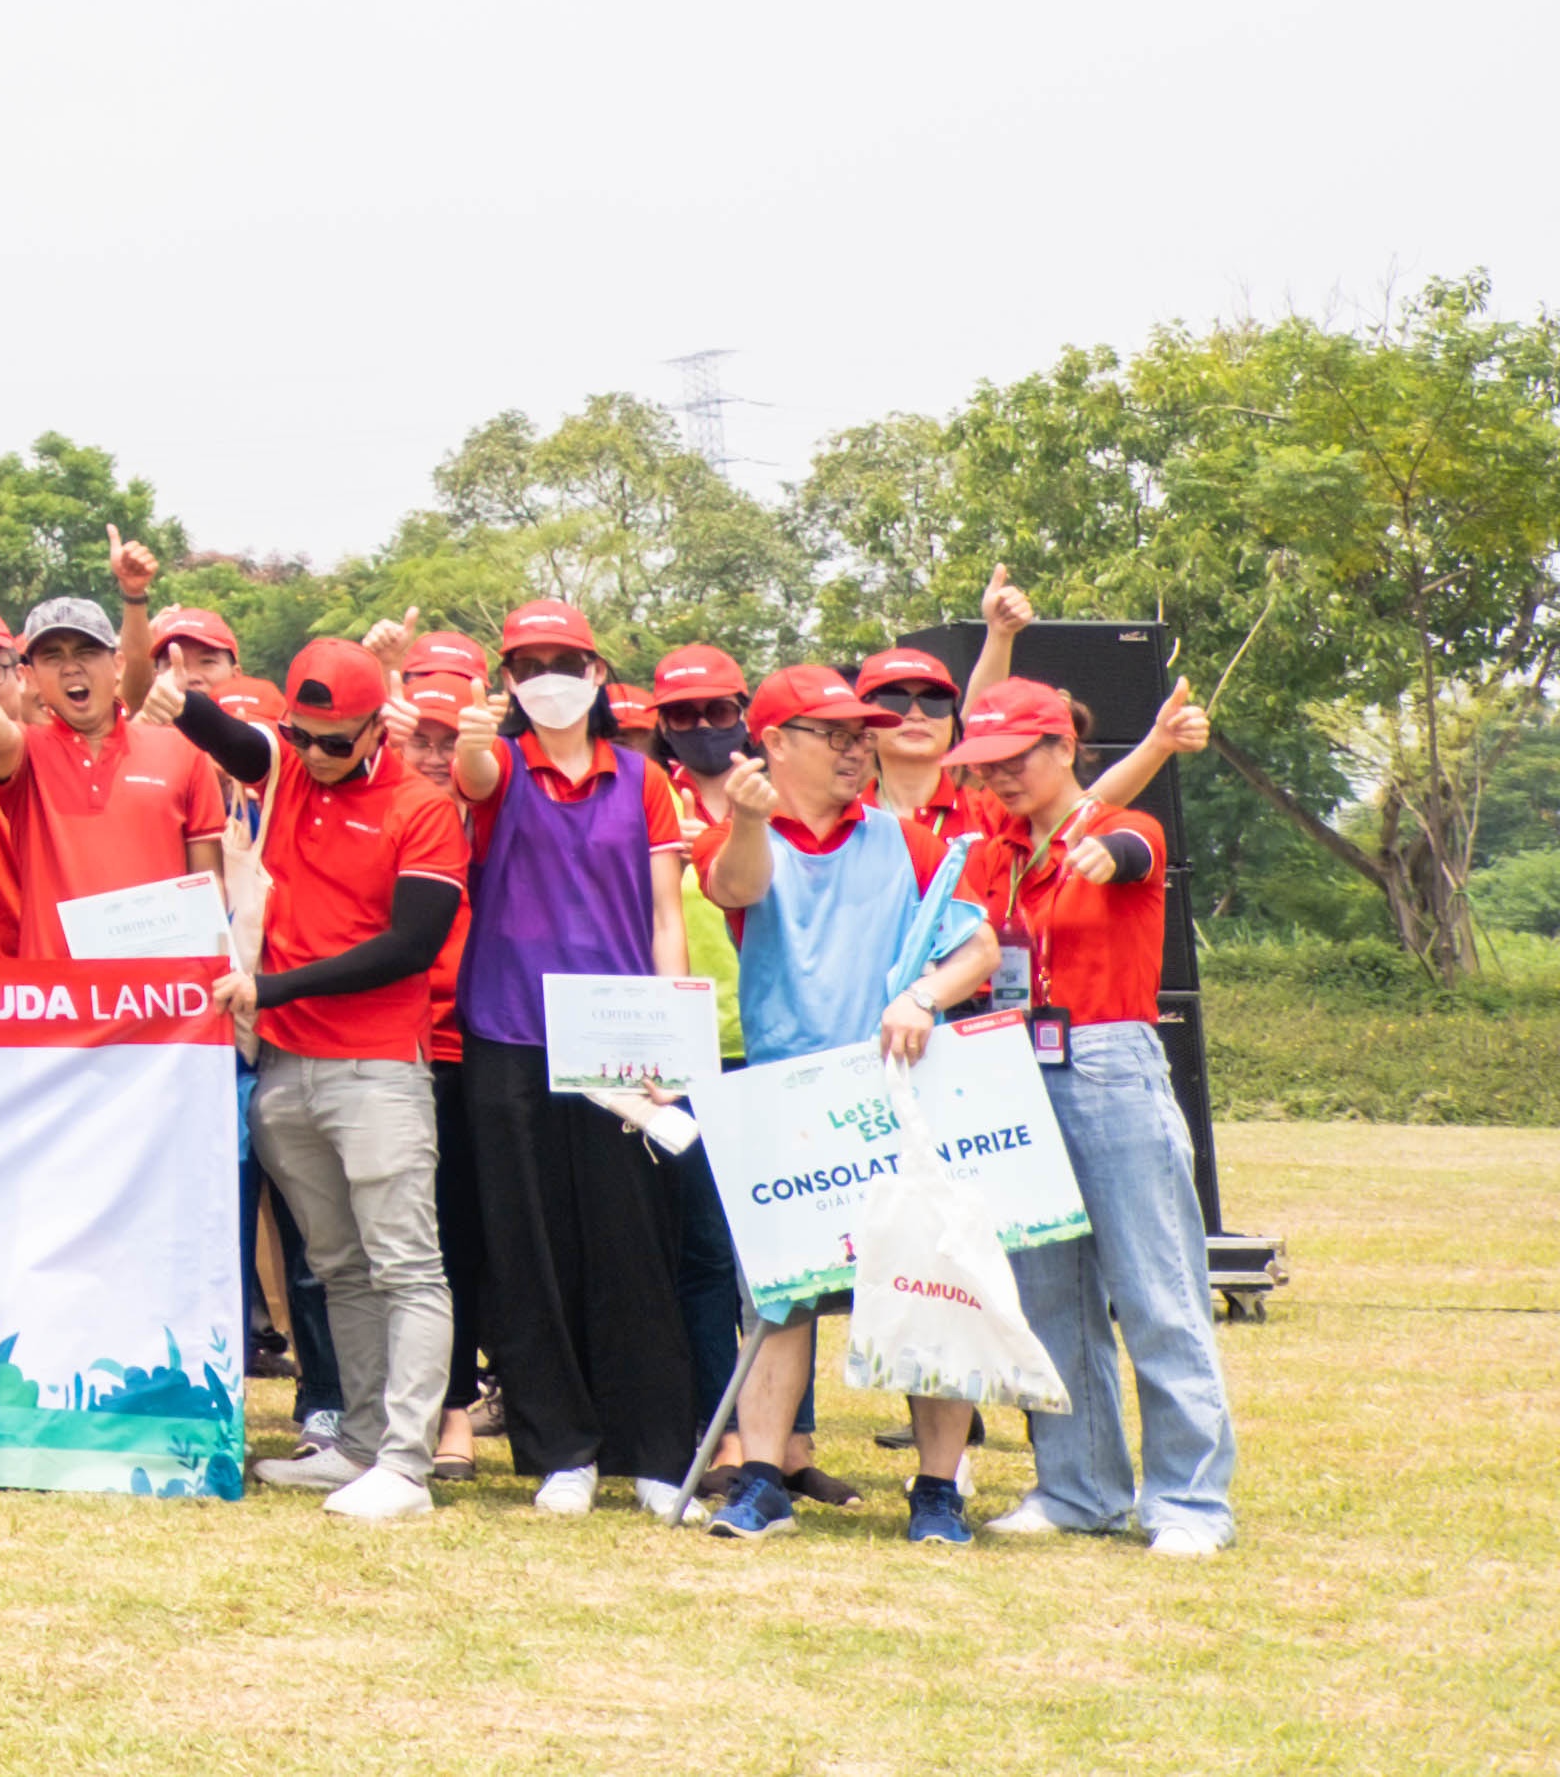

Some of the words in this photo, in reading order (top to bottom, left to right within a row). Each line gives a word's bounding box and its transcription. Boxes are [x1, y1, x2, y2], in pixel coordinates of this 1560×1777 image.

[90, 982, 209, 1020] LAND
[751, 1142, 951, 1205] CONSOLATN
[956, 1124, 1032, 1159] PRIZE
[893, 1275, 983, 1311] GAMUDA
